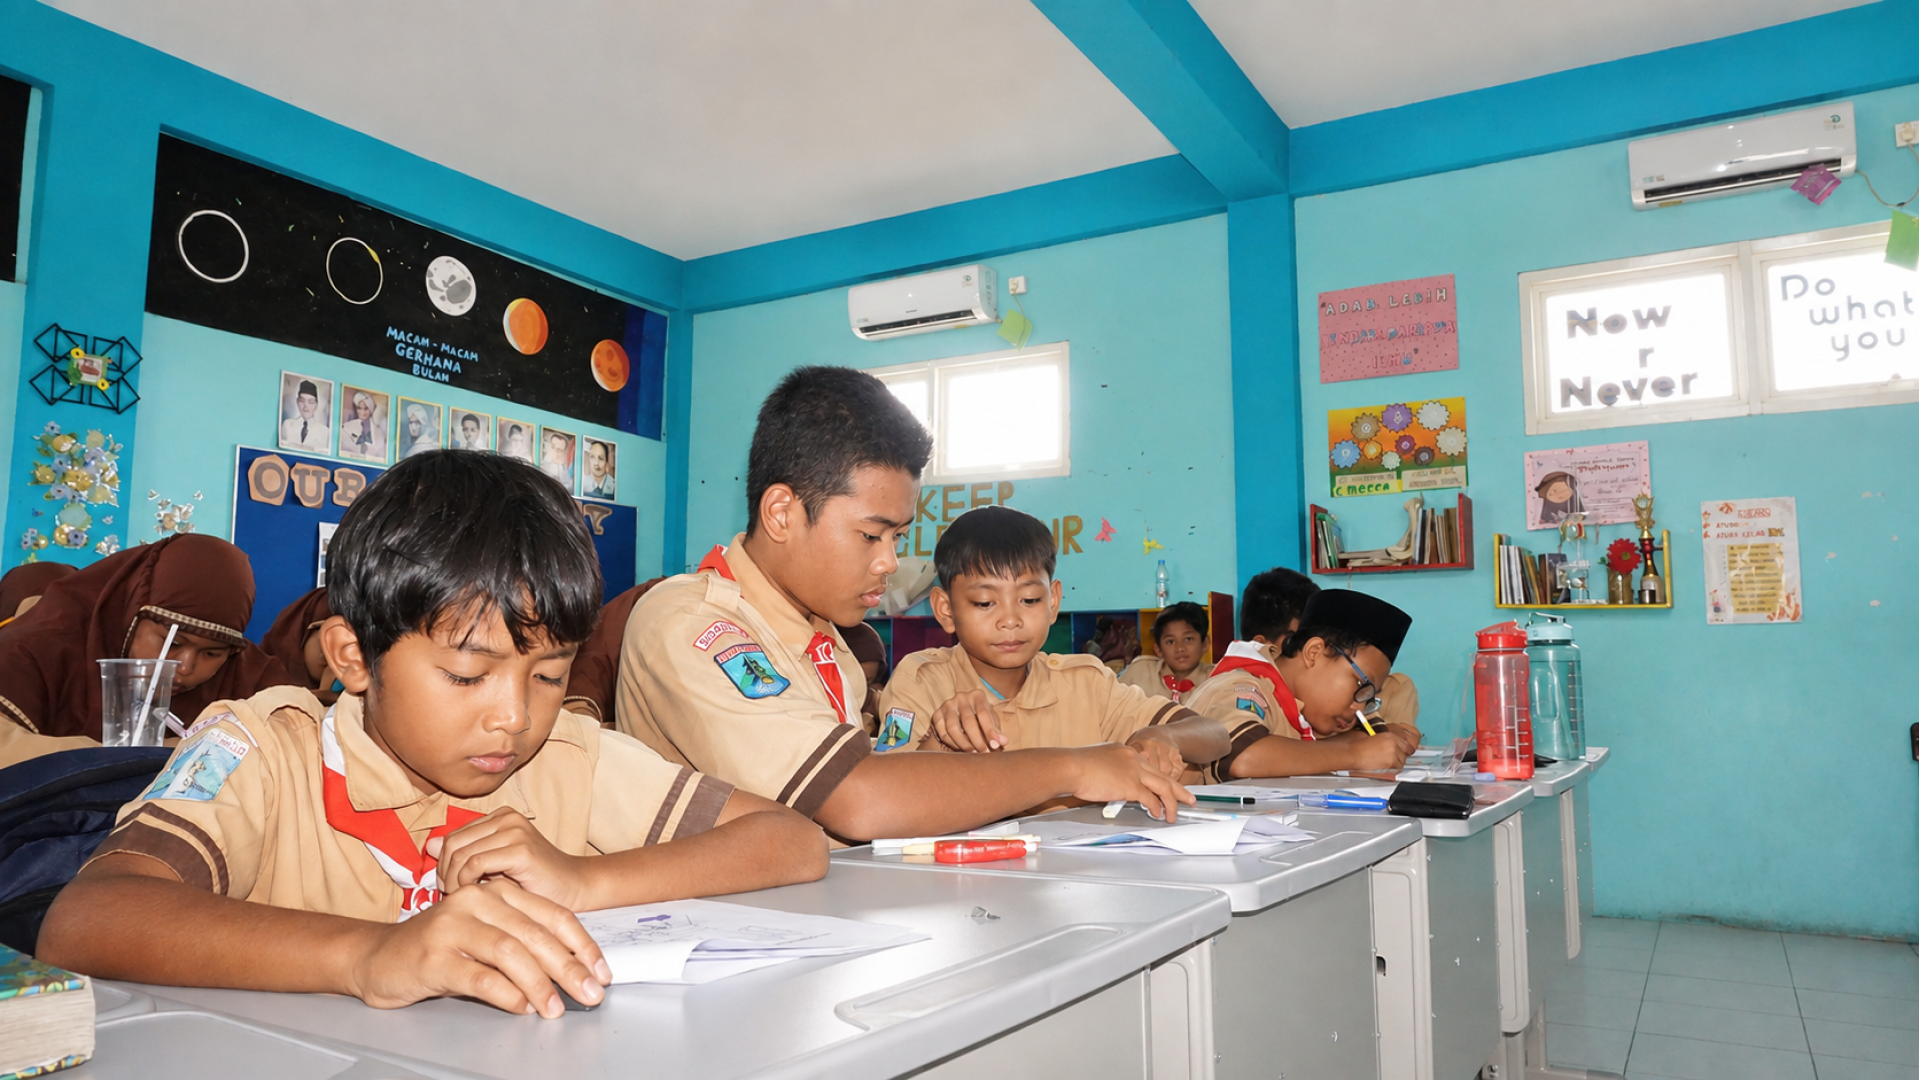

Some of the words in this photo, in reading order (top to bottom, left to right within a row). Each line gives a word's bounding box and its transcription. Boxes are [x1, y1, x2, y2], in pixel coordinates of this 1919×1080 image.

[1780, 274, 1836, 301] Do
[1566, 305, 1672, 339] Now
[1809, 290, 1914, 326] what
[386, 326, 429, 348] MACAM
[440, 342, 479, 362] MACAM
[395, 342, 462, 373] GERHANA
[1831, 327, 1905, 362] you
[1560, 372, 1698, 408] Never
[253, 460, 366, 507] OUR
[916, 481, 1014, 523] KEEP
